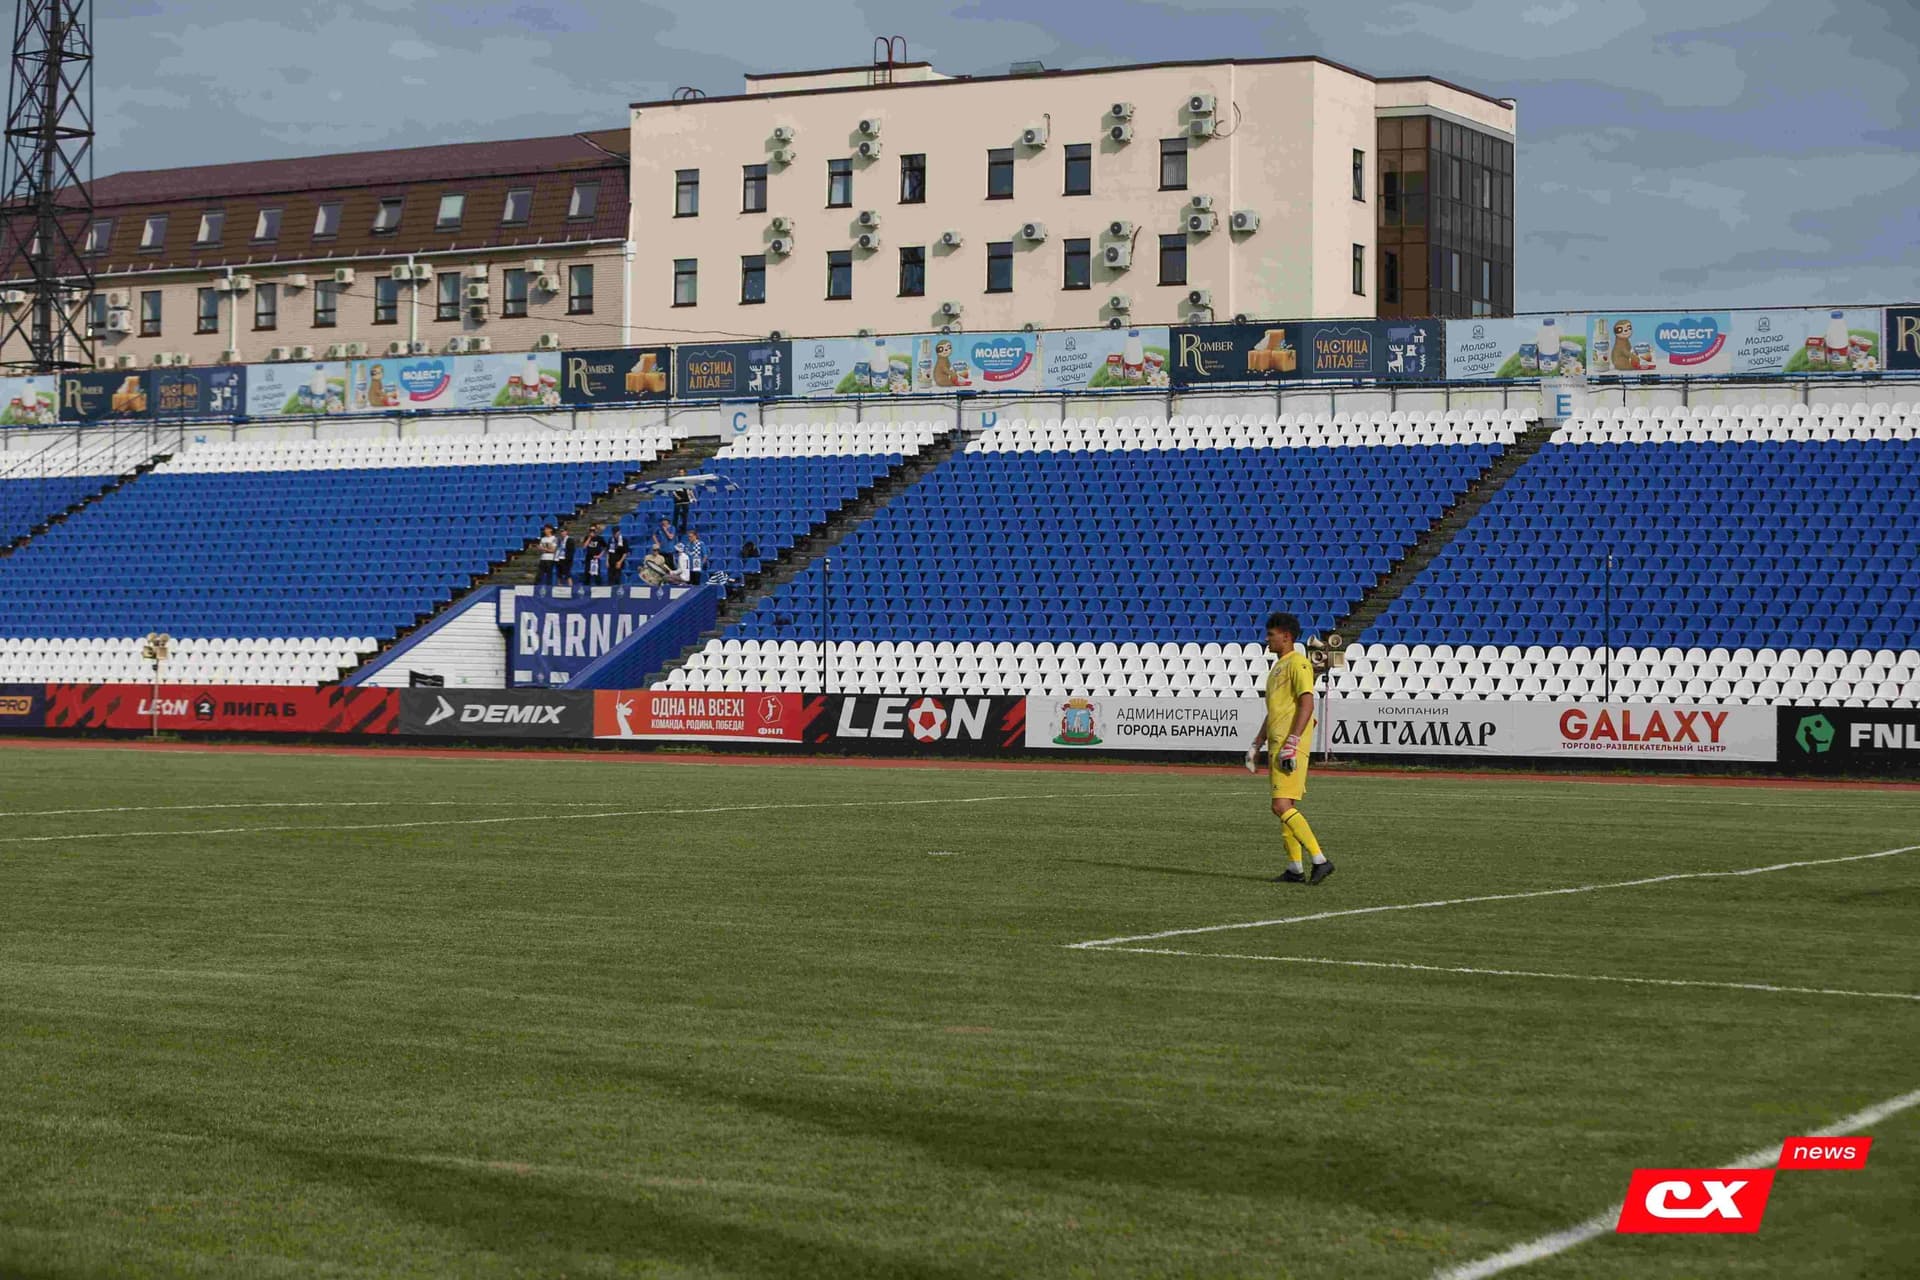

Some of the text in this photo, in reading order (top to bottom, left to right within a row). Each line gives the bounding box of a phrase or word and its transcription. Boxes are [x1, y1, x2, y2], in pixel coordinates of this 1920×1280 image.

[1659, 328, 1714, 341] МОДЕСТ
[1745, 333, 1784, 345] Молоко
[975, 346, 1023, 360] МОДЕСТ
[1316, 339, 1369, 355] ЧАСТИЦА
[1460, 340, 1497, 353] Молоко
[1054, 352, 1088, 363] Молоко
[1178, 333, 1234, 376] ROMBER
[689, 360, 733, 376] ЧАСТИЦА
[1317, 355, 1354, 369] АЛТАЯ
[689, 376, 721, 389] АЛТАЯ
[1556, 393, 1572, 416] E
[520, 611, 655, 657] BARNA
[137, 698, 189, 716] LEON
[200, 702, 211, 713] 2
[460, 704, 567, 724] DEMIX
[651, 697, 745, 718] ОДНА НА ВСЕХ!
[1378, 706, 1450, 716] КОМПАНИЯ
[836, 696, 992, 743] LEON
[1116, 707, 1239, 722] АДМИНИСТРАЦИЯ
[651, 719, 745, 731] КОМАНДА, РОДИНА, ПОБЕДА!
[757, 727, 784, 735] ФНЛ
[1116, 724, 1239, 738] ГОРОДА БАРНАУЛА
[1559, 708, 1729, 743] GALAXY
[1331, 719, 1497, 747] АЛТАМАР
[1562, 742, 1727, 753] ТОРГОВО-РАЗВЛЕКАТЕЛЬНЫЙ ЦЕНТР
